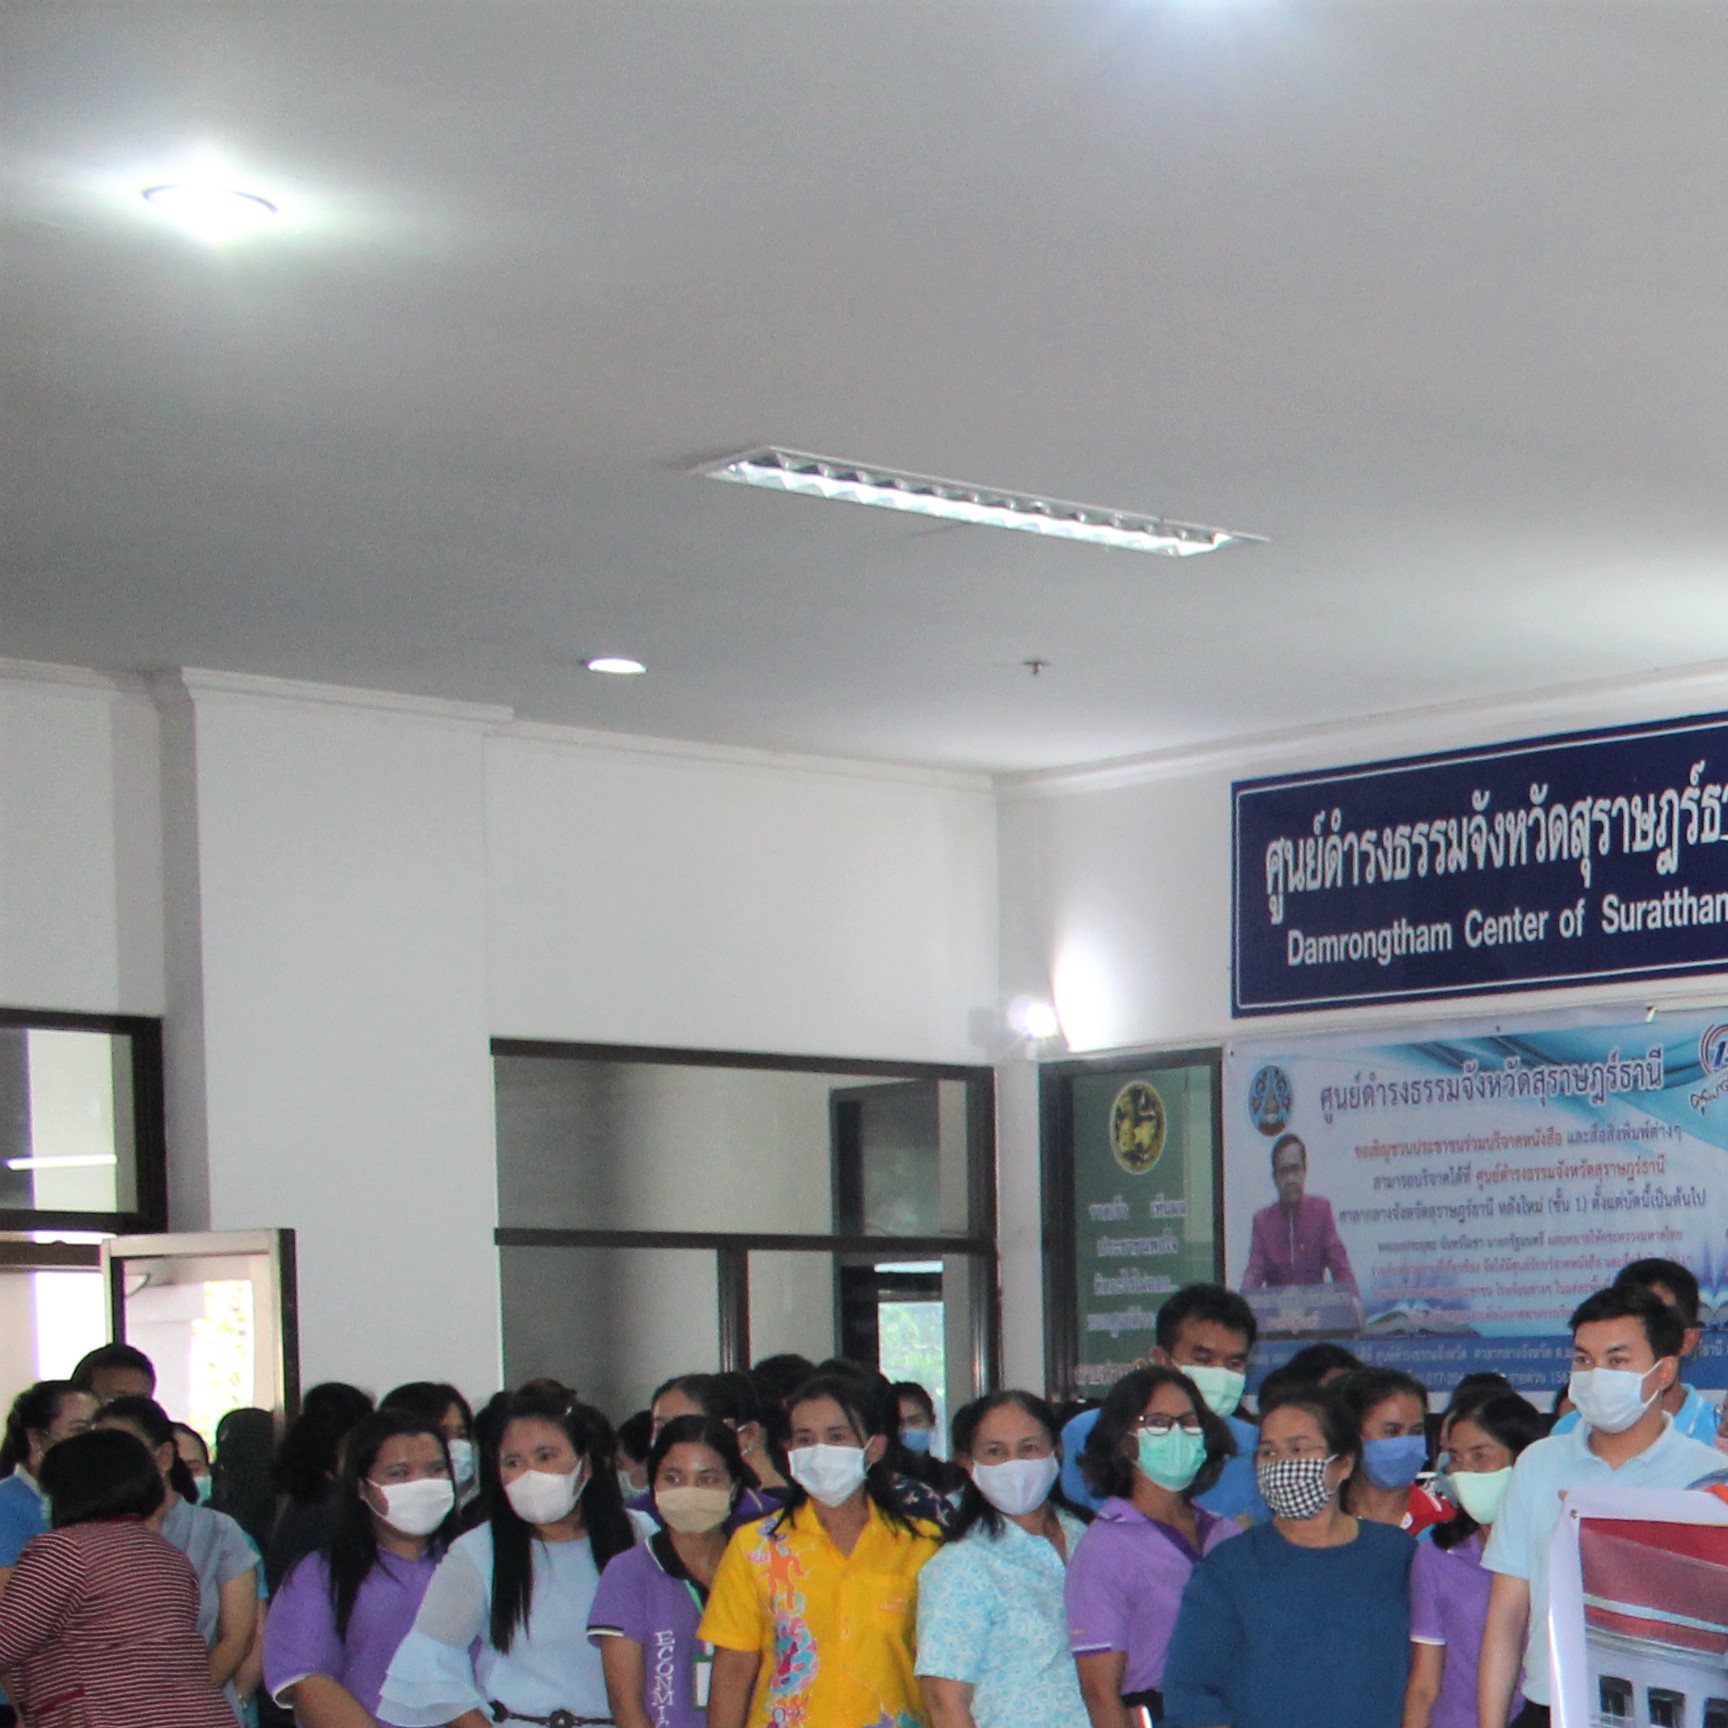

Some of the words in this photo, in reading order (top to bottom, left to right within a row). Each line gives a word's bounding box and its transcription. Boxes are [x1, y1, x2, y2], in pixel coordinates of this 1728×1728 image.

[1287, 917, 1452, 966] Damrongtham
[1464, 905, 1549, 948] Center
[1559, 897, 1586, 938] of
[1320, 1045, 1664, 1124] ศูนย์ดำรงธรรมจังหวัดสุราษฎร์ธานี
